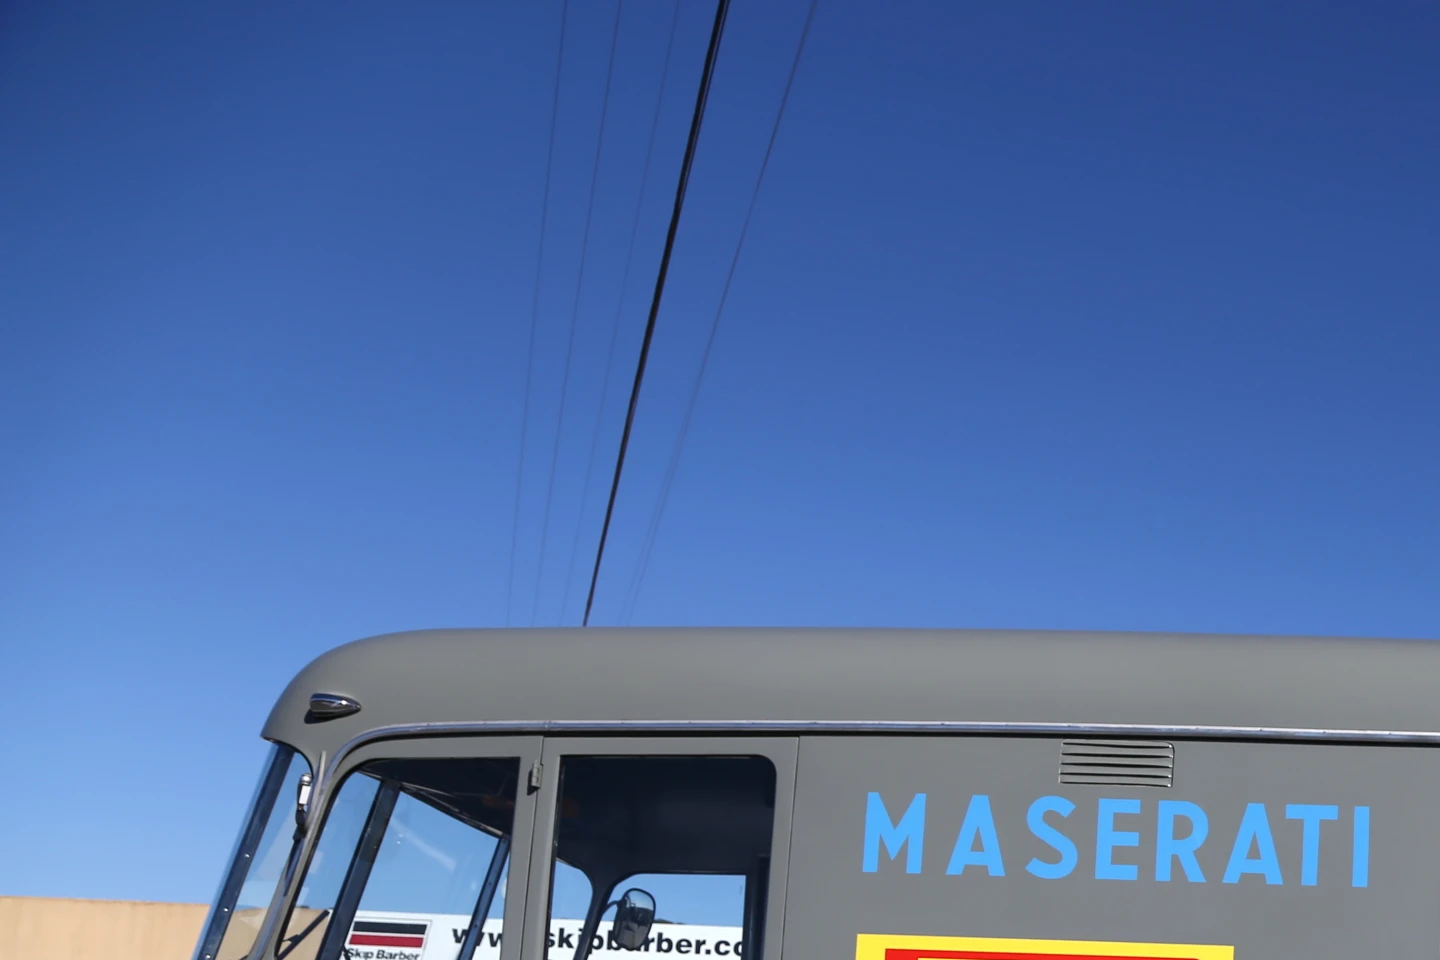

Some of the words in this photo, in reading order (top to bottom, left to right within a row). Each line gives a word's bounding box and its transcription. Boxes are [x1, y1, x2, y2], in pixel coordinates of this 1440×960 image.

[862, 791, 1370, 887] MASERATI
[346, 948, 373, 960] Skip
[376, 949, 420, 960] Barber
